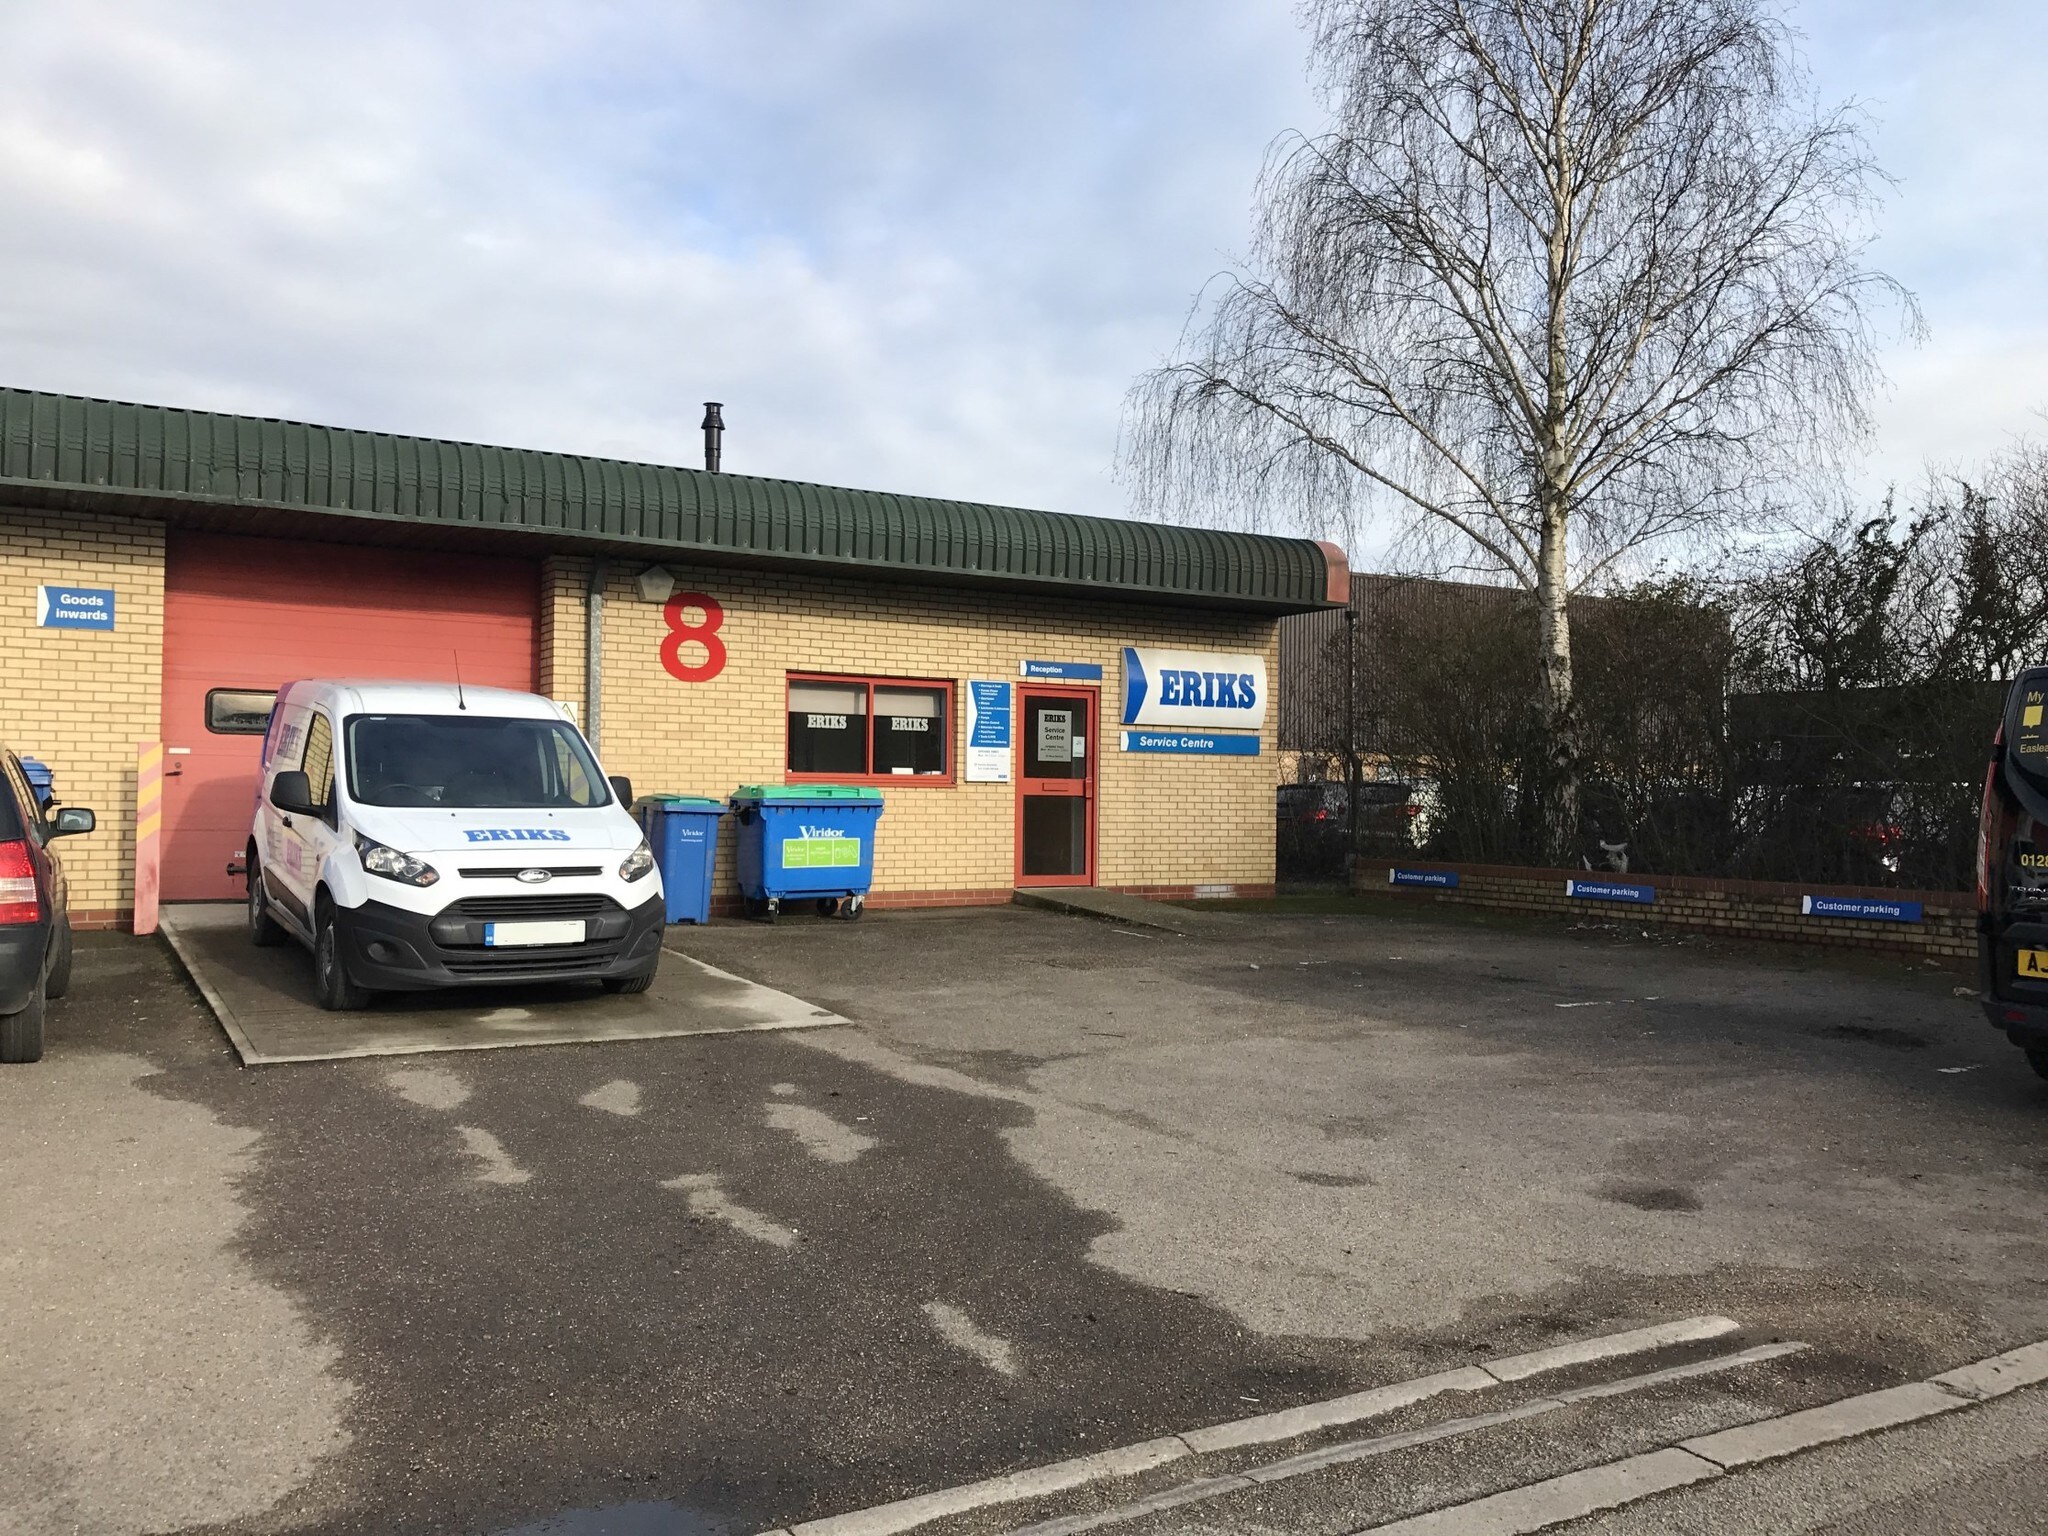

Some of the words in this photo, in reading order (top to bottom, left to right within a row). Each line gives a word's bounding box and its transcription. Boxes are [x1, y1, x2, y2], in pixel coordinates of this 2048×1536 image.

[60, 593, 104, 607] Goods
[55, 608, 108, 621] inwards
[660, 592, 727, 682] 8
[1030, 665, 1063, 674] Reception
[1159, 669, 1257, 710] ERIKS
[2027, 691, 2045, 704] My
[807, 714, 848, 730] ERIKS
[891, 717, 930, 732] ERIKS
[1044, 714, 1066, 723] ERIKS
[1139, 736, 1178, 748] Service
[1180, 738, 1215, 749] Centre
[463, 829, 571, 843] ERIKS
[682, 829, 705, 837] Viridor
[799, 825, 845, 839] Viridor
[1397, 872, 1424, 881] Customer
[1424, 875, 1446, 884] parking
[1577, 884, 1611, 895] Customer
[1611, 888, 1639, 898] parking
[1816, 900, 1861, 912] Customer
[1863, 905, 1900, 916] parking
